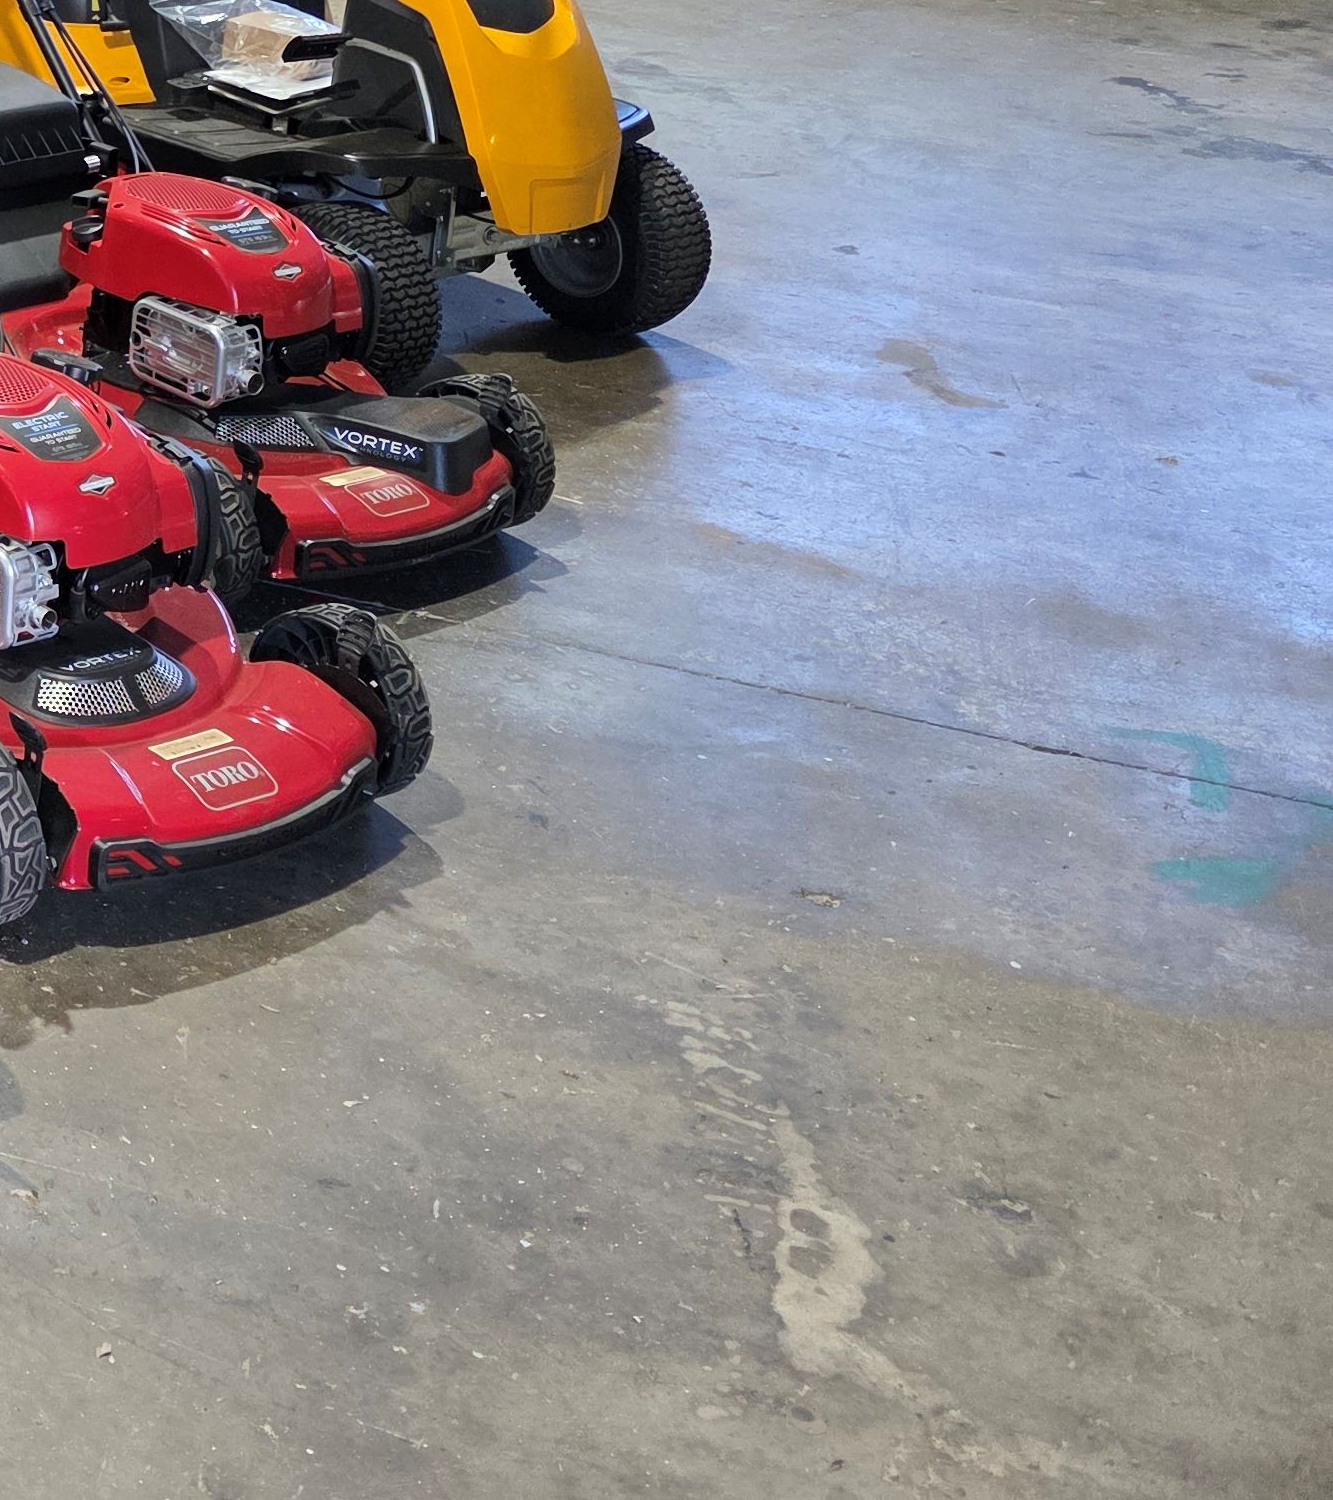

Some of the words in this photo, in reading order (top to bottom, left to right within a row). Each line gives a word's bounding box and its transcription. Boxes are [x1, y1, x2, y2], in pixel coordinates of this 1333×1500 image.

[11, 411, 70, 430] ELECTRIC
[30, 420, 62, 432] START
[29, 427, 82, 443] GUARANTEED
[55, 434, 78, 444] START
[334, 426, 419, 459] VORTEX
[360, 483, 414, 505] TORO
[59, 647, 142, 672] VORTEX
[189, 760, 260, 793] TORO
